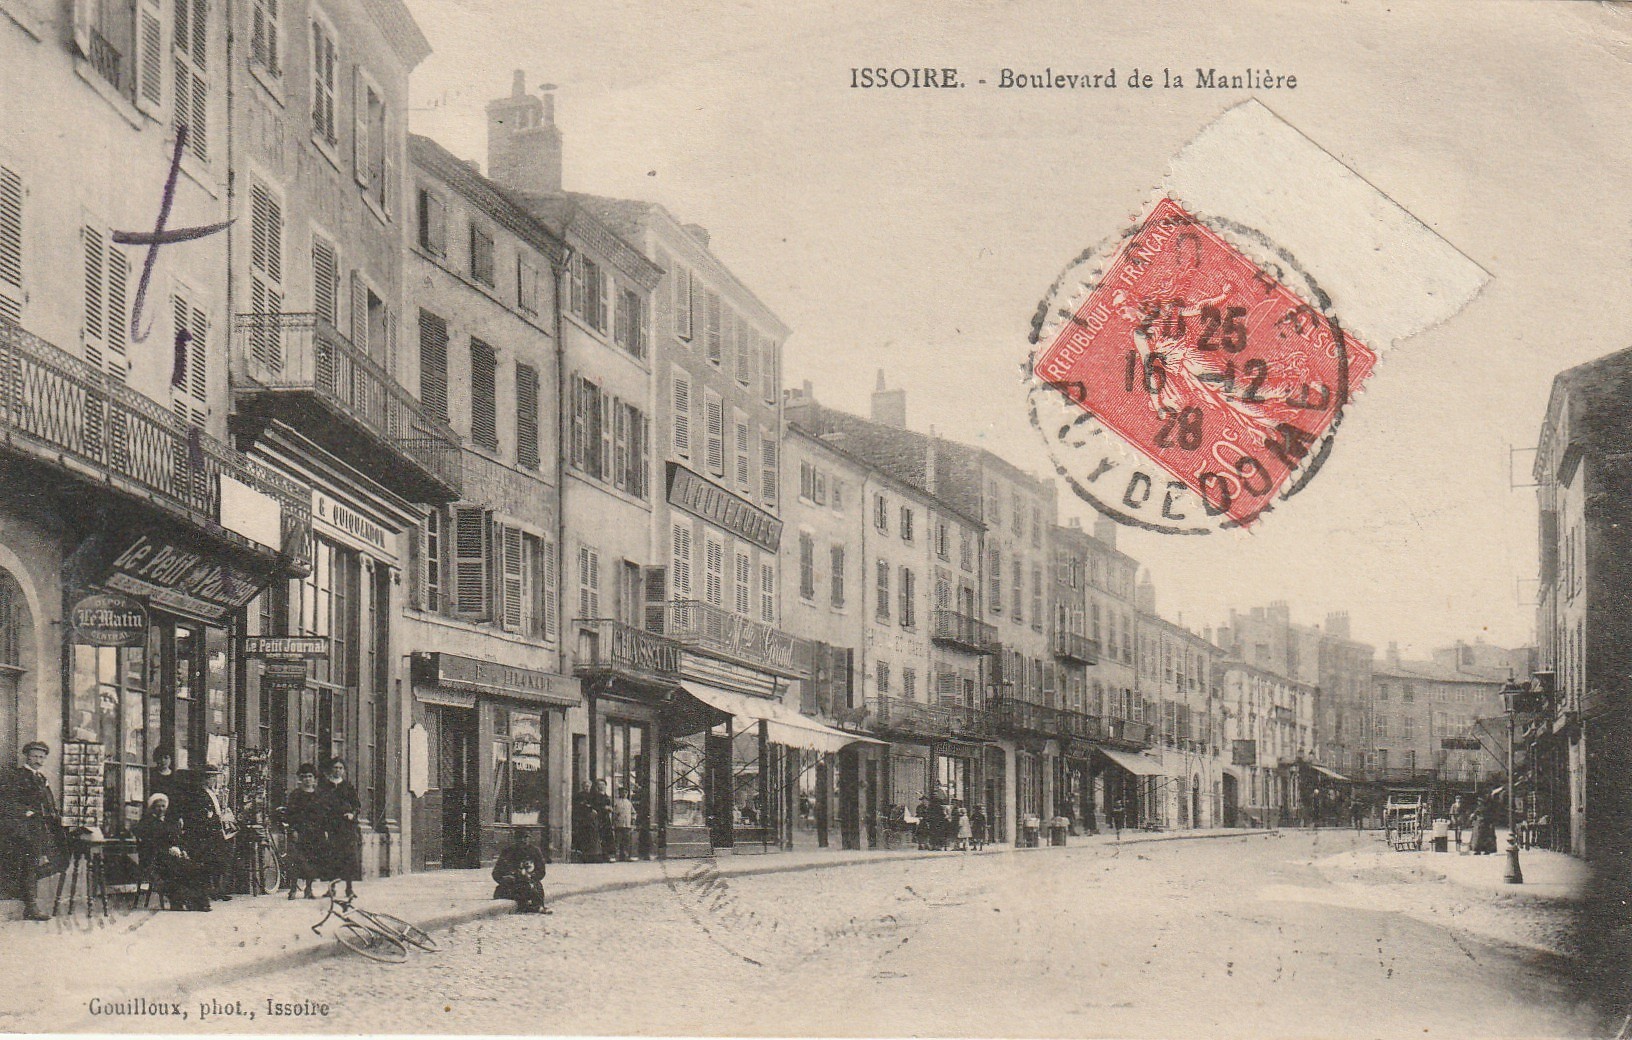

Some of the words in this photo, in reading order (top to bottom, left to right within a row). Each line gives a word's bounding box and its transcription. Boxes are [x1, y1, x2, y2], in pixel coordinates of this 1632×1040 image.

[1197, 305, 1247, 353] 25
[113, 535, 152, 570] Le
[138, 544, 200, 585] Petit
[77, 608, 97, 627] Le
[95, 609, 143, 628] Matin
[245, 638, 257, 653] Le
[259, 638, 283, 653] Petit
[284, 638, 325, 653] Journal
